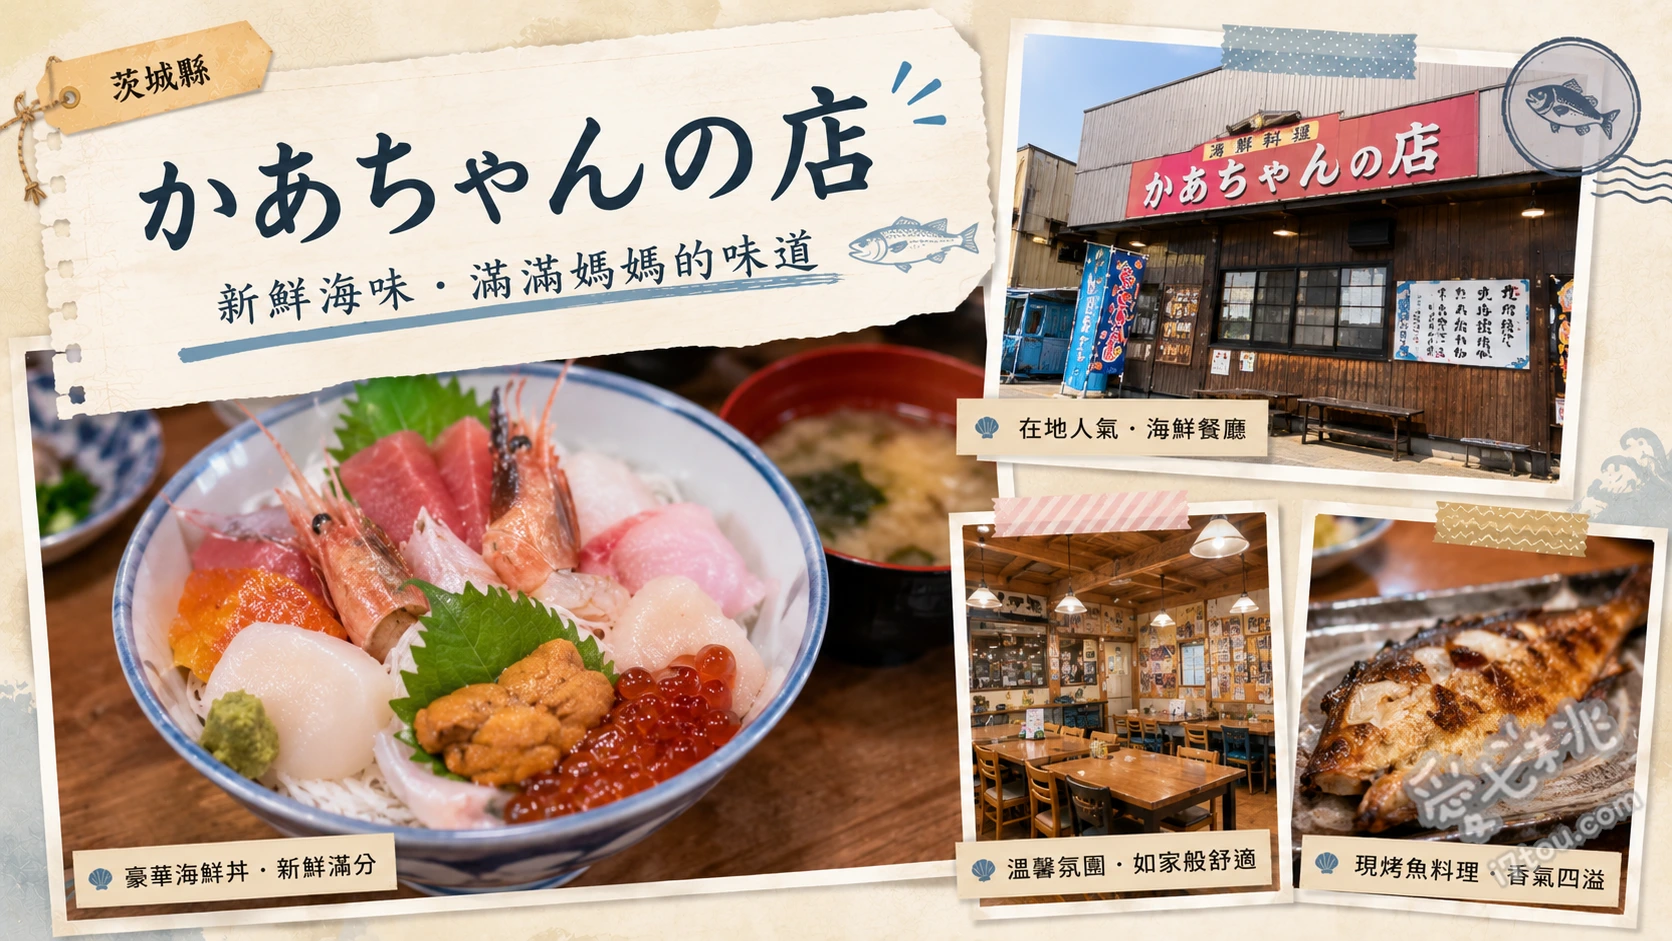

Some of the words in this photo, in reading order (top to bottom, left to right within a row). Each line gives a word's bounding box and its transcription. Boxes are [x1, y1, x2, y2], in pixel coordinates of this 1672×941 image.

[1143, 121, 1440, 208] かあちゃんの店
